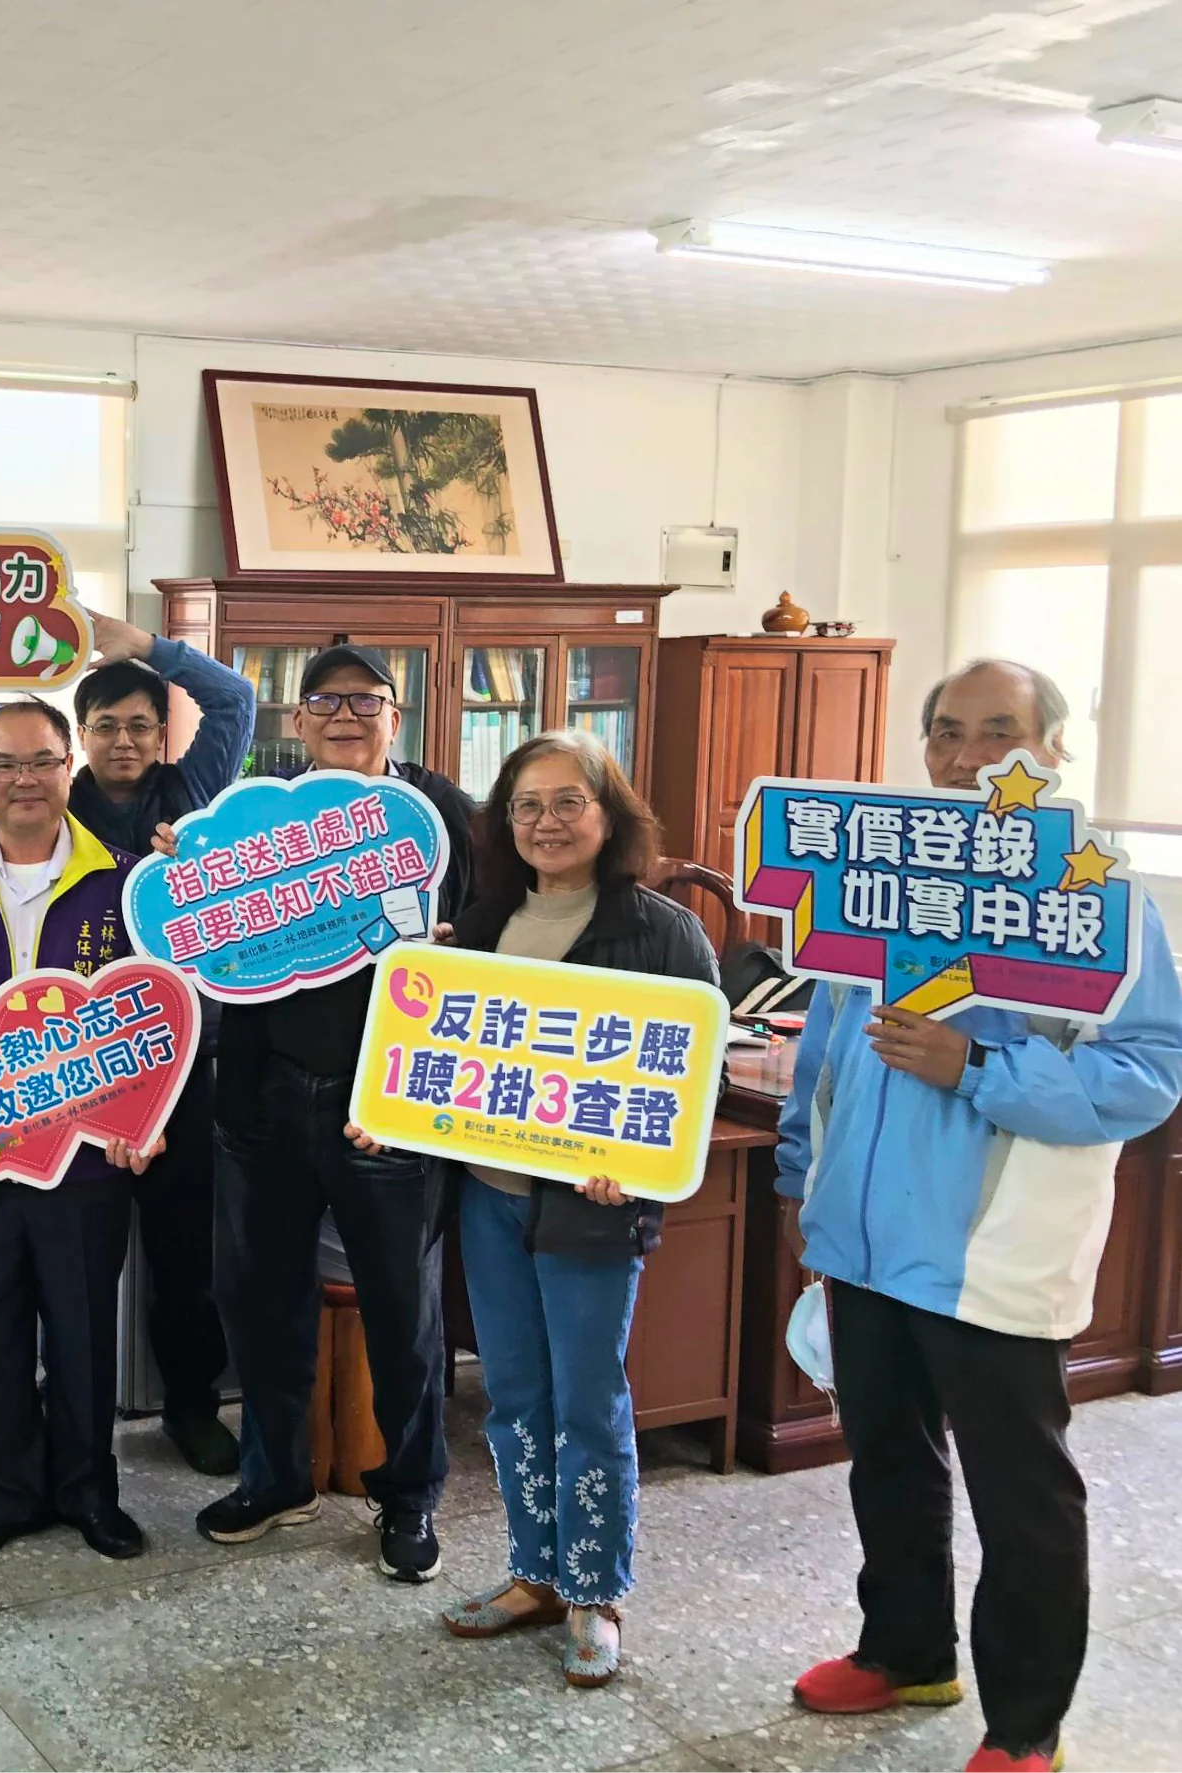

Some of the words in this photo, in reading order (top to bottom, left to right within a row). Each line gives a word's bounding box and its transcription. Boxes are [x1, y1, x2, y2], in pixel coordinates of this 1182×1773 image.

[166, 796, 386, 904] 指定送達處所
[787, 801, 1034, 877] 實價登錄
[99, 909, 116, 967] 二林地
[166, 840, 426, 959] 重要通知不錯過
[843, 867, 1103, 957] 如實申報
[431, 995, 690, 1074] 反詐三步驟
[384, 1047, 678, 1146] 1聽2掛3查證
